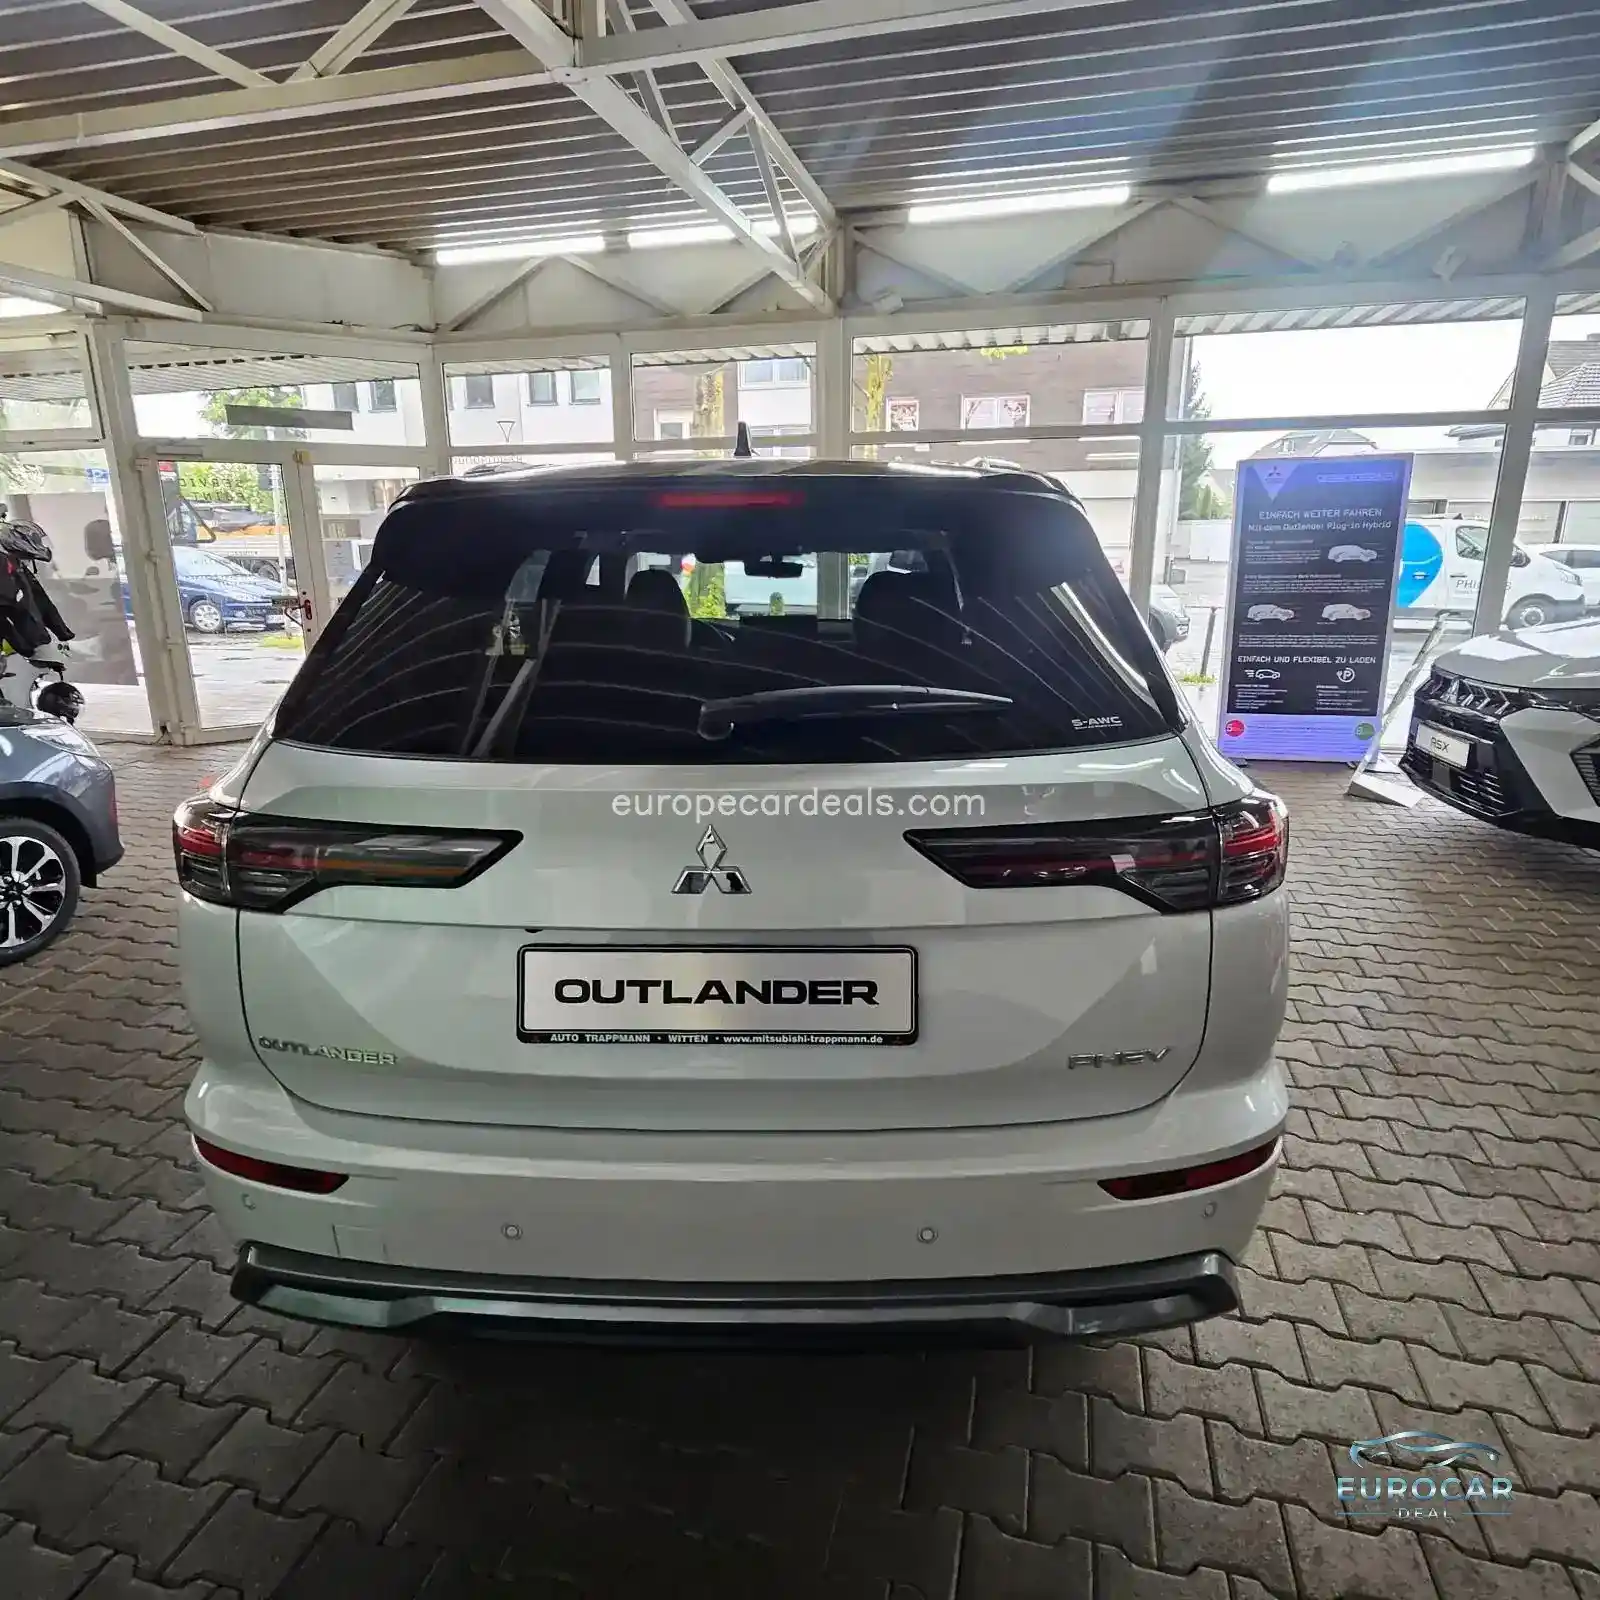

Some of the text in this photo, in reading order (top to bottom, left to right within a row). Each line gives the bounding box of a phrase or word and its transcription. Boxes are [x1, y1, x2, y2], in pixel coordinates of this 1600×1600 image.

[1259, 508, 1383, 520] EINFACH WEITER FAHREN
[1326, 520, 1361, 532] Plug-in
[1362, 519, 1392, 531] Hybrid
[1237, 655, 1376, 665] EINFACH UND FLEXIBEL ZU LADEN
[1071, 716, 1122, 727] S-AWC
[1431, 736, 1450, 753] ASX
[554, 978, 880, 1006] OUTLANDER
[550, 1033, 884, 1045] AUTO TRAPPMANN WITTEN www.mitsubishi-trappmann.de
[258, 1036, 397, 1066] OUTLANDER
[1067, 1047, 1171, 1070] PHEV
